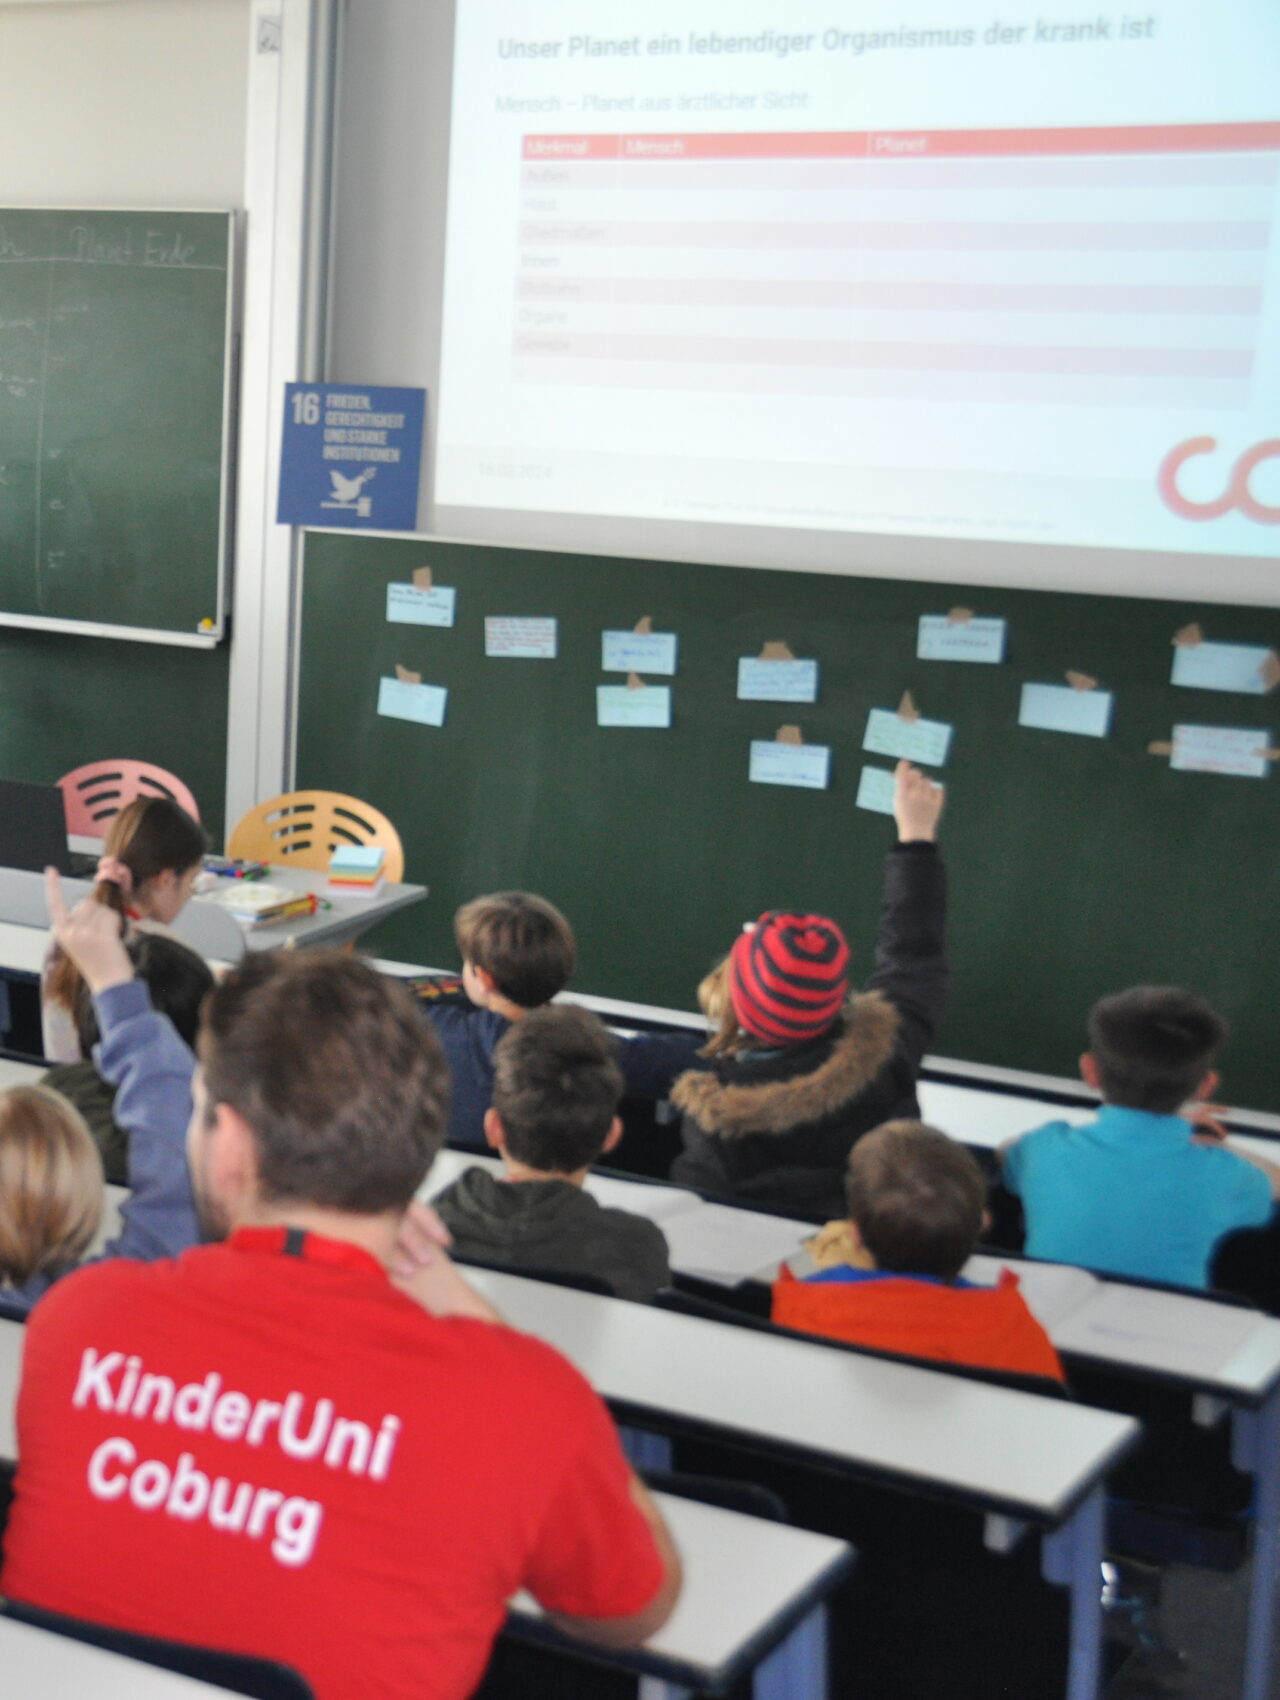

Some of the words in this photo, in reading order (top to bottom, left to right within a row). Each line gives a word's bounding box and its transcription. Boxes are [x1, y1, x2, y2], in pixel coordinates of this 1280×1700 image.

[496, 35, 563, 60] Unser
[569, 33, 641, 59] Planet
[646, 33, 681, 56] ein
[687, 26, 816, 58] lebendiger
[821, 25, 976, 56] Organismus
[983, 20, 1026, 46] der
[1034, 15, 1112, 43] krank
[1121, 13, 1157, 40] ist
[494, 94, 562, 114] Mensch
[581, 93, 636, 112] Planet
[639, 96, 670, 112] aus
[676, 90, 757, 112] ärztlicher
[761, 89, 810, 110] Sicht
[625, 139, 686, 156] Mensch
[875, 136, 928, 152] Planet
[291, 392, 320, 425] 16
[324, 410, 406, 429] GERECHTIGKEIT
[322, 445, 401, 463] INSTITUTIONEN
[72, 1346, 402, 1482] KinderUni
[86, 1436, 325, 1570] Coburg
